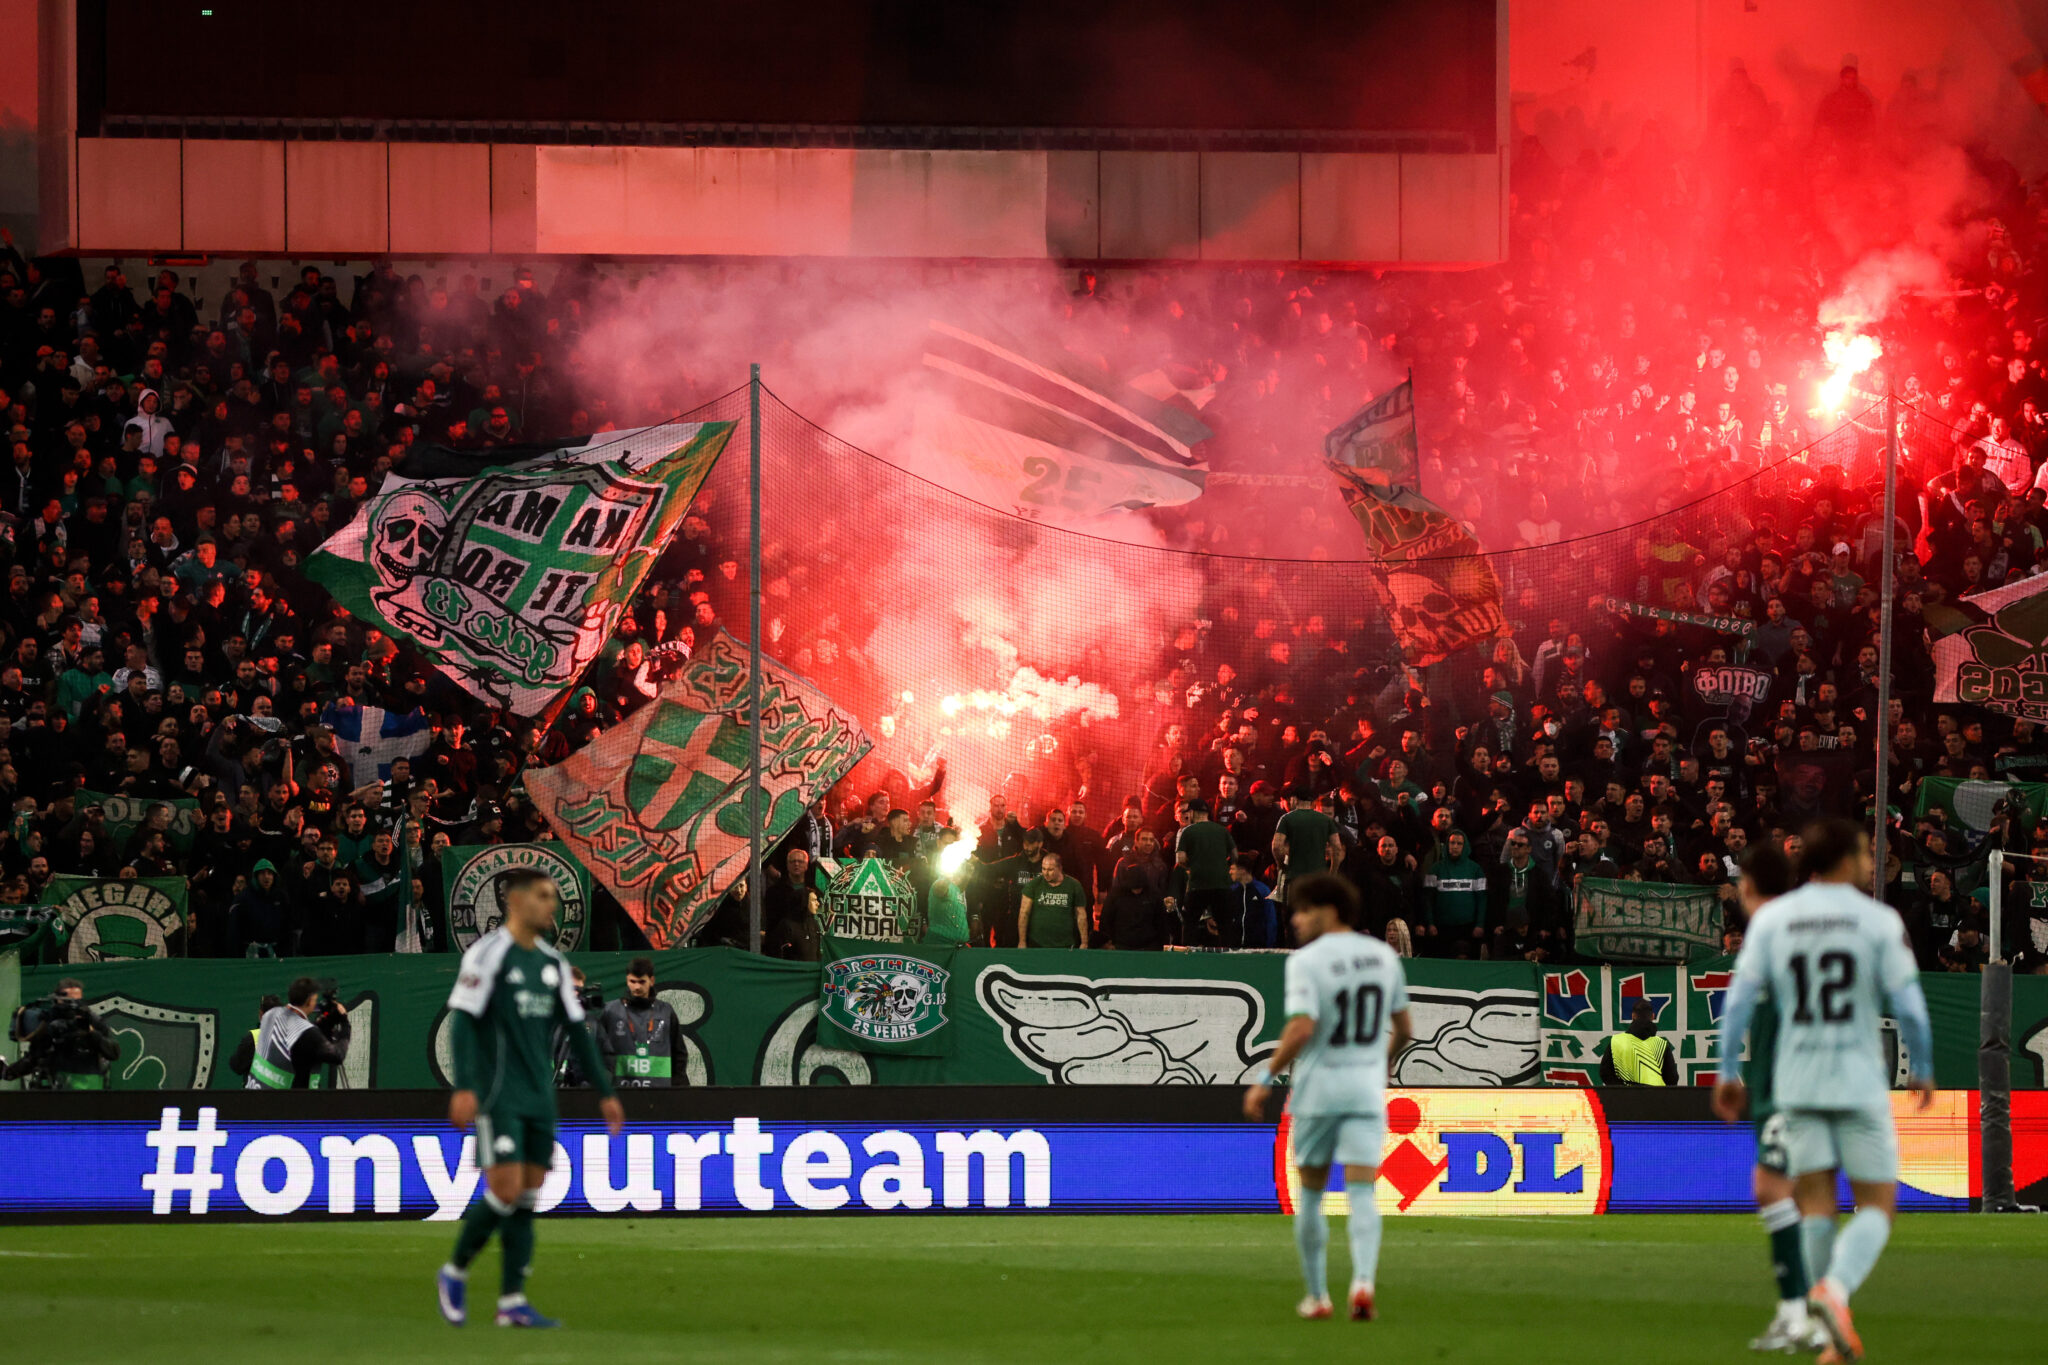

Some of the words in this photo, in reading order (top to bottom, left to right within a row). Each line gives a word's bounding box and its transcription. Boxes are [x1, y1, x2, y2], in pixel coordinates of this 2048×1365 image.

[828, 892, 913, 917] GREEN
[817, 914, 919, 937] VANDALS
[1788, 949, 1857, 1025] 12
[1329, 983, 1384, 1047] 10
[873, 1022, 918, 1039] YEARS
[627, 1058, 651, 1074] HB
